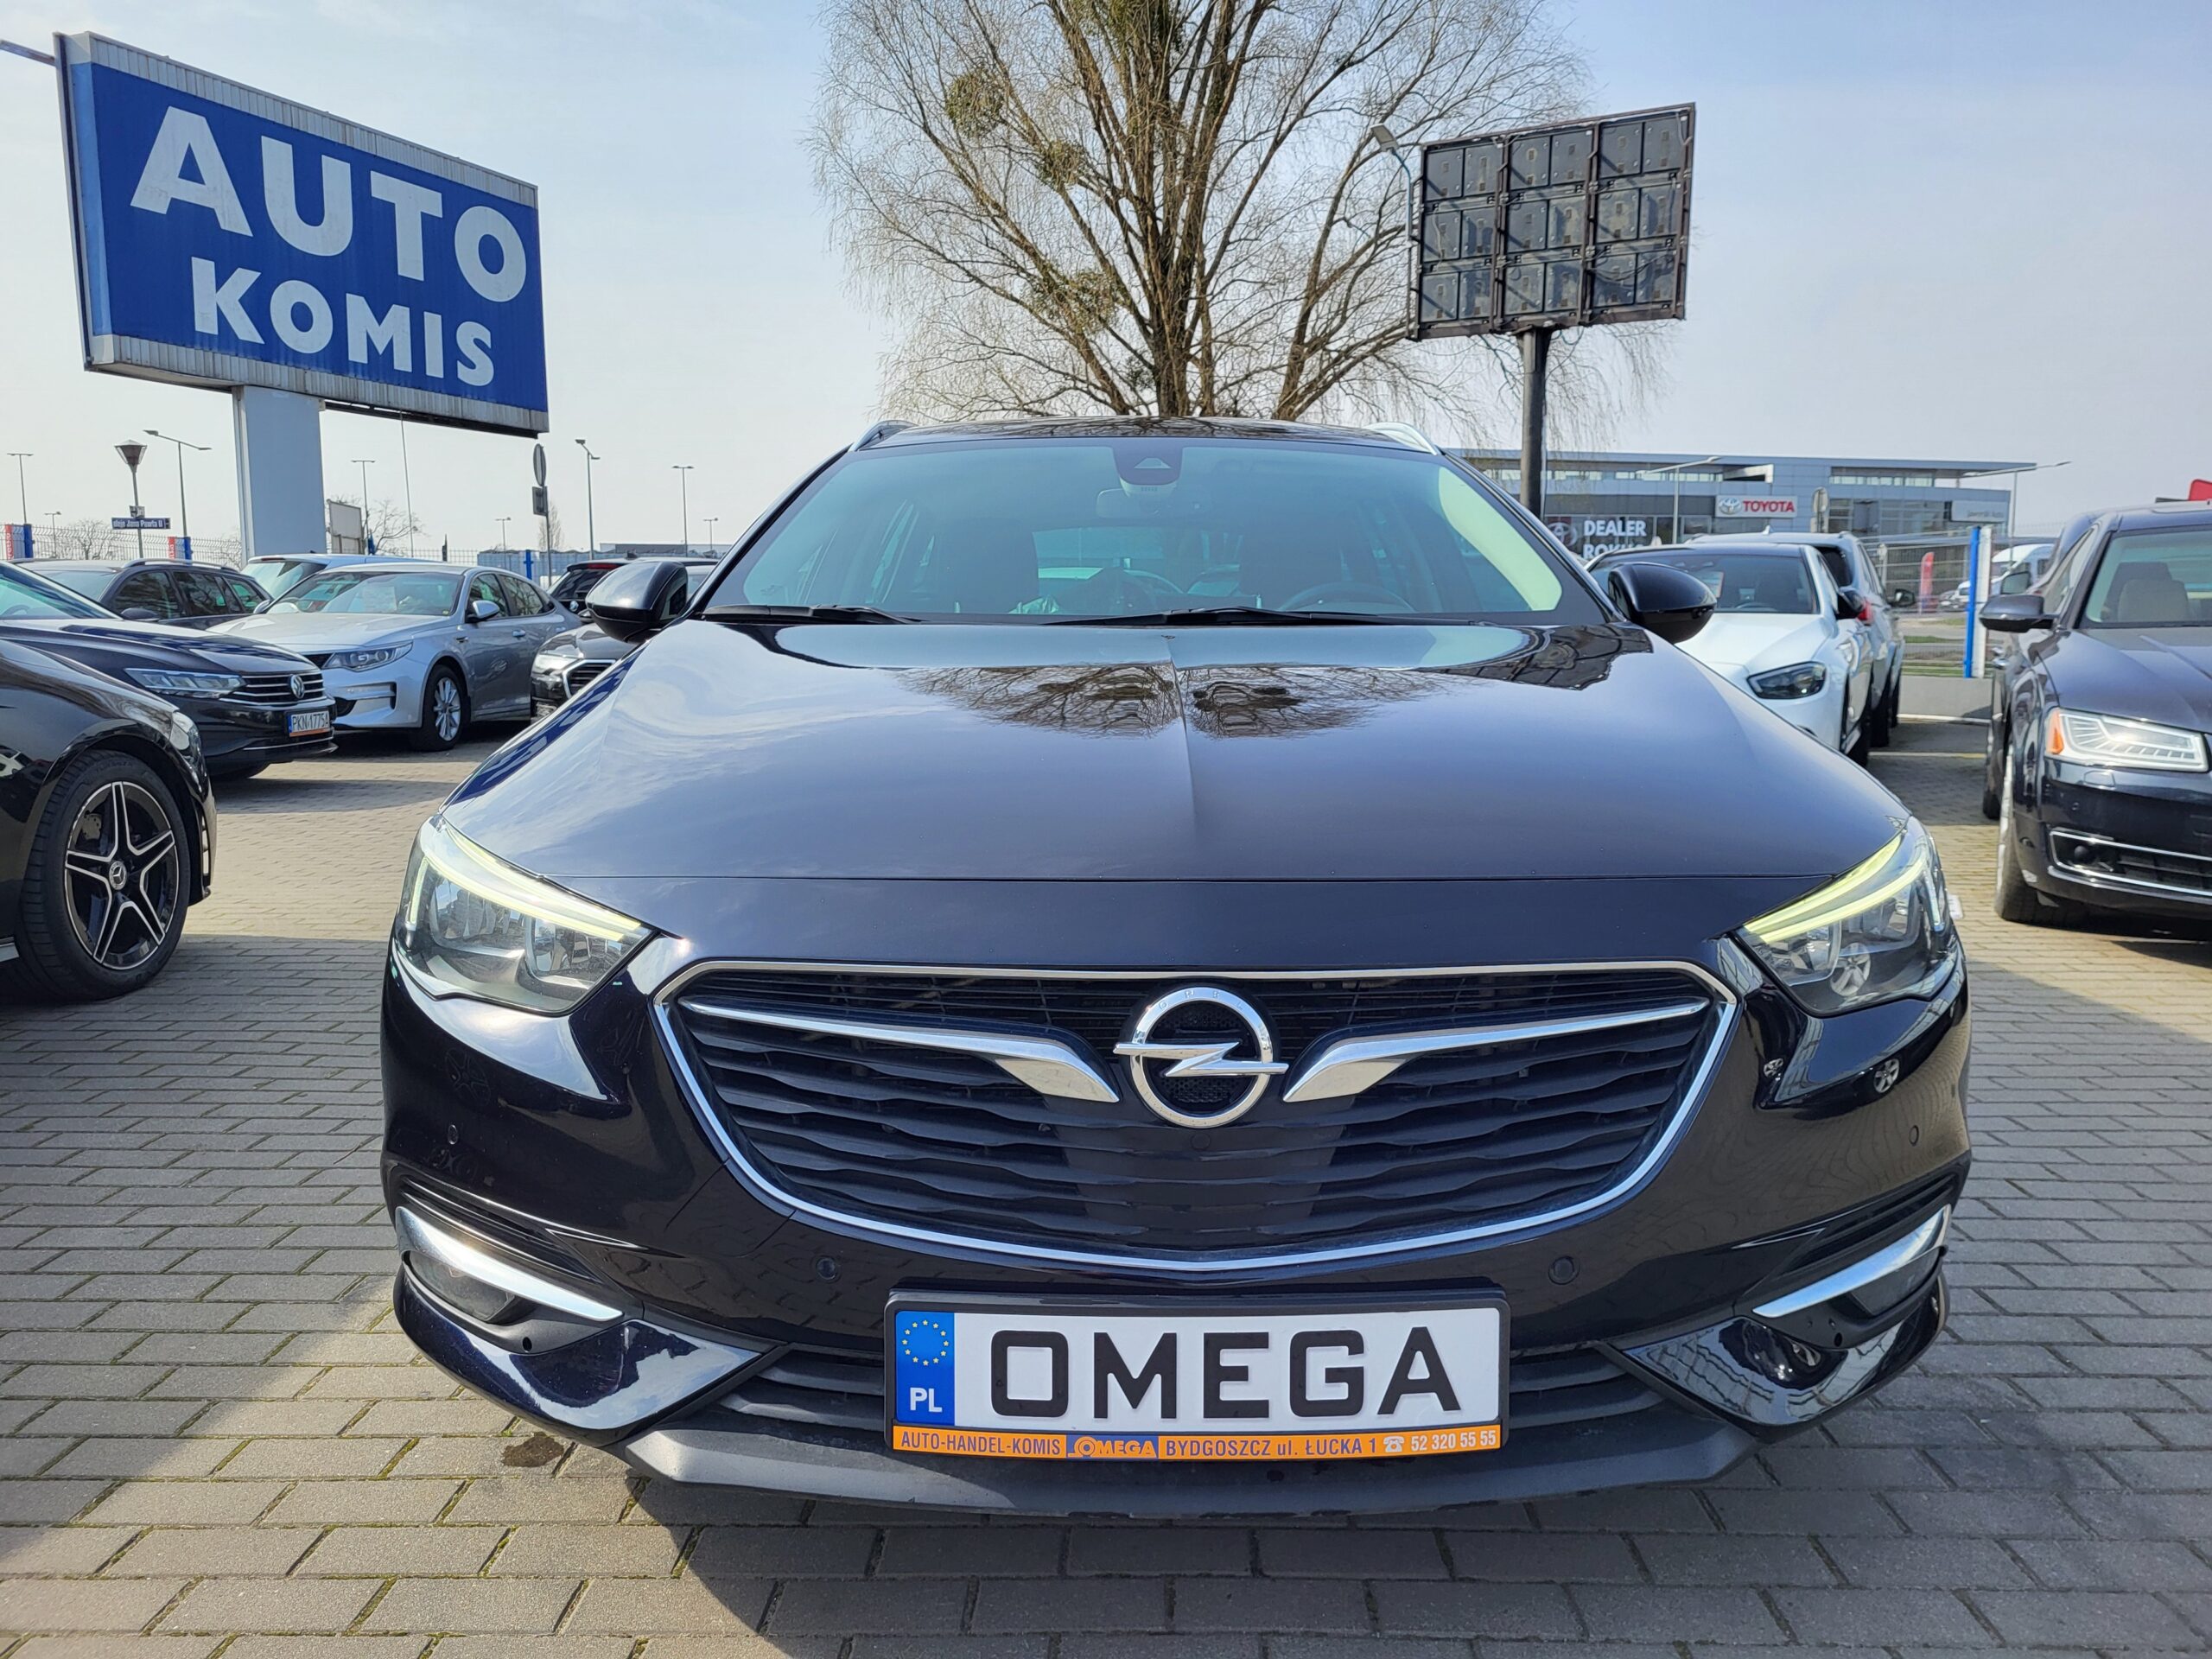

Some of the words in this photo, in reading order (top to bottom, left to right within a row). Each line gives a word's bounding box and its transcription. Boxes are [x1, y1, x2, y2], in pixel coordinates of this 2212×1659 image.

[130, 105, 526, 302] AUTO
[191, 257, 494, 386] KOMIS
[1743, 500, 1795, 512] TOYOTA
[1584, 520, 1647, 536] DEALER
[990, 1326, 1461, 1419] OMEGA
[910, 1387, 943, 1412] PL
[901, 1431, 1061, 1455] AUTO-HANDEL-KOMIS
[1067, 1435, 1157, 1459] OMEGA
[1166, 1440, 1271, 1456] BYDGOSZCZ
[1277, 1439, 1298, 1456] ul.
[1305, 1437, 1363, 1455] ŁUCKA
[1369, 1437, 1376, 1453] 1
[1411, 1435, 1427, 1452] 52
[1431, 1433, 1456, 1450] 320
[1459, 1431, 1477, 1448] 55
[1479, 1429, 1497, 1446] 55
